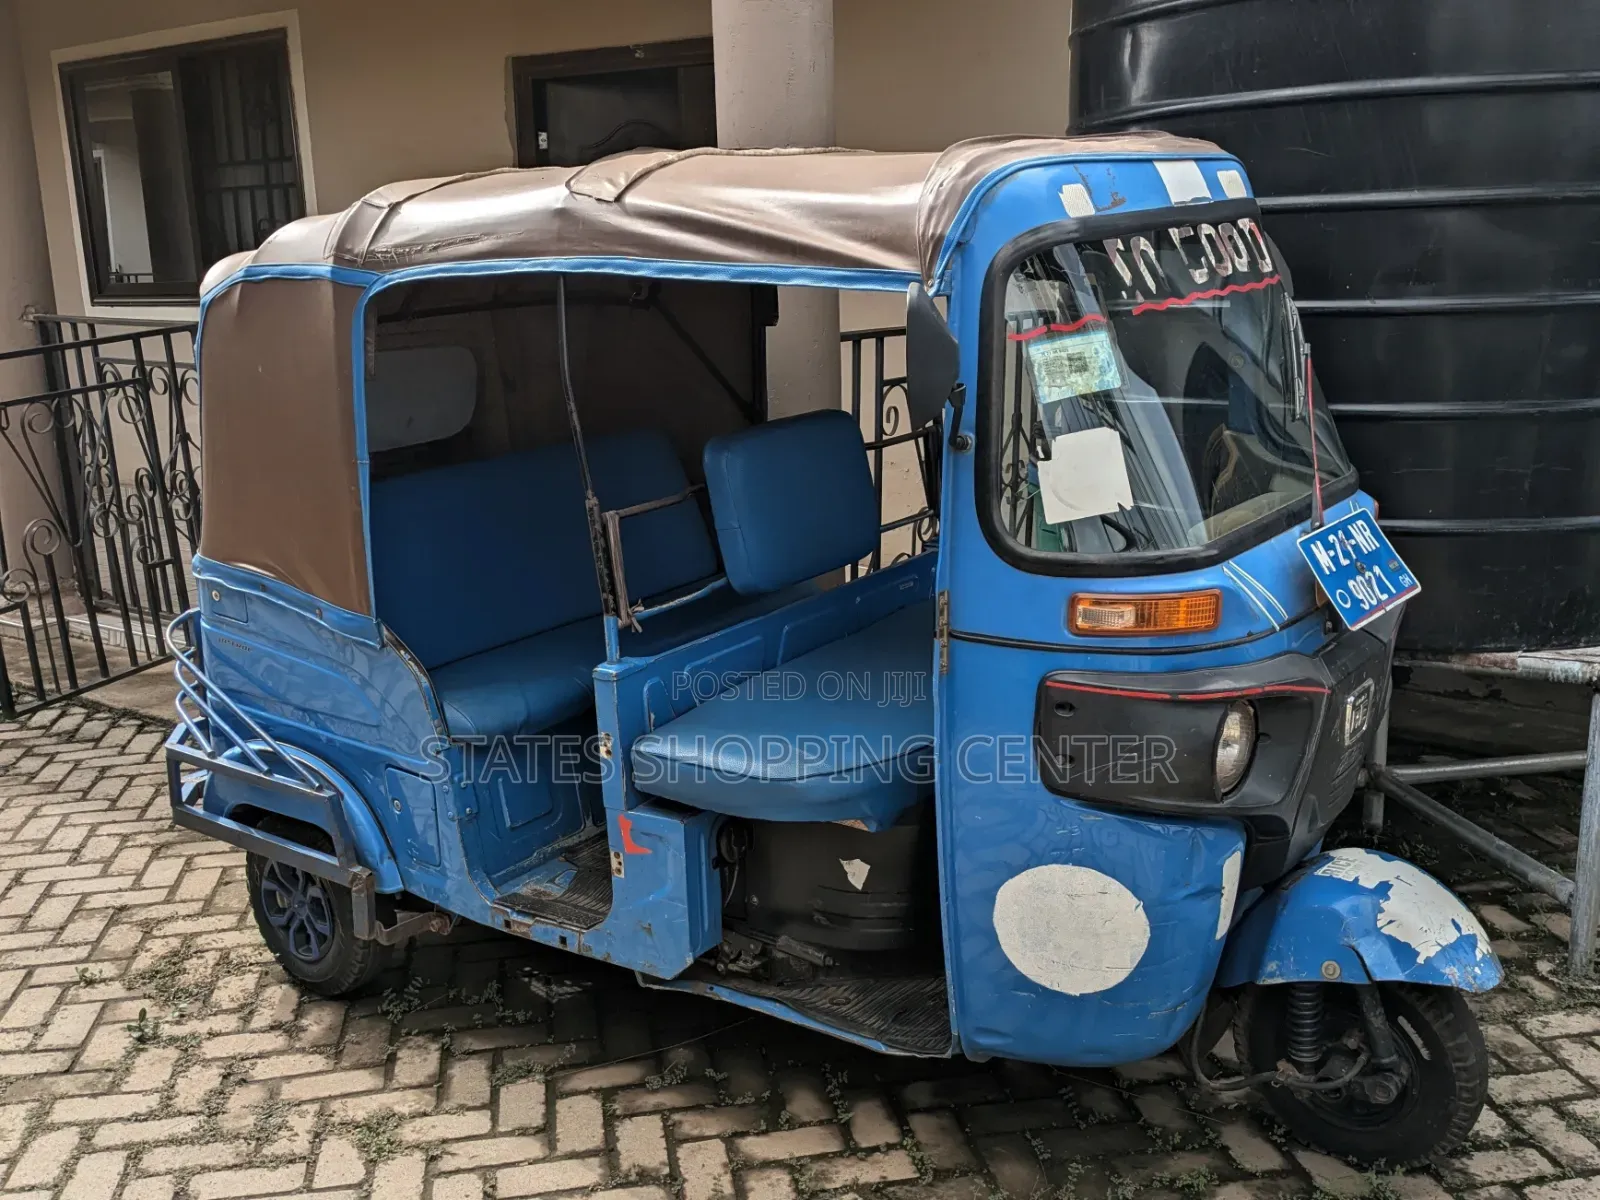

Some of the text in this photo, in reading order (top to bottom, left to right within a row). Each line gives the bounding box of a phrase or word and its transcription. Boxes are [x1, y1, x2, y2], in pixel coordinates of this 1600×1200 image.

[1310, 519, 1380, 575] M-21-NR
[1347, 565, 1396, 610] 9021
[1398, 573, 1413, 588] GH
